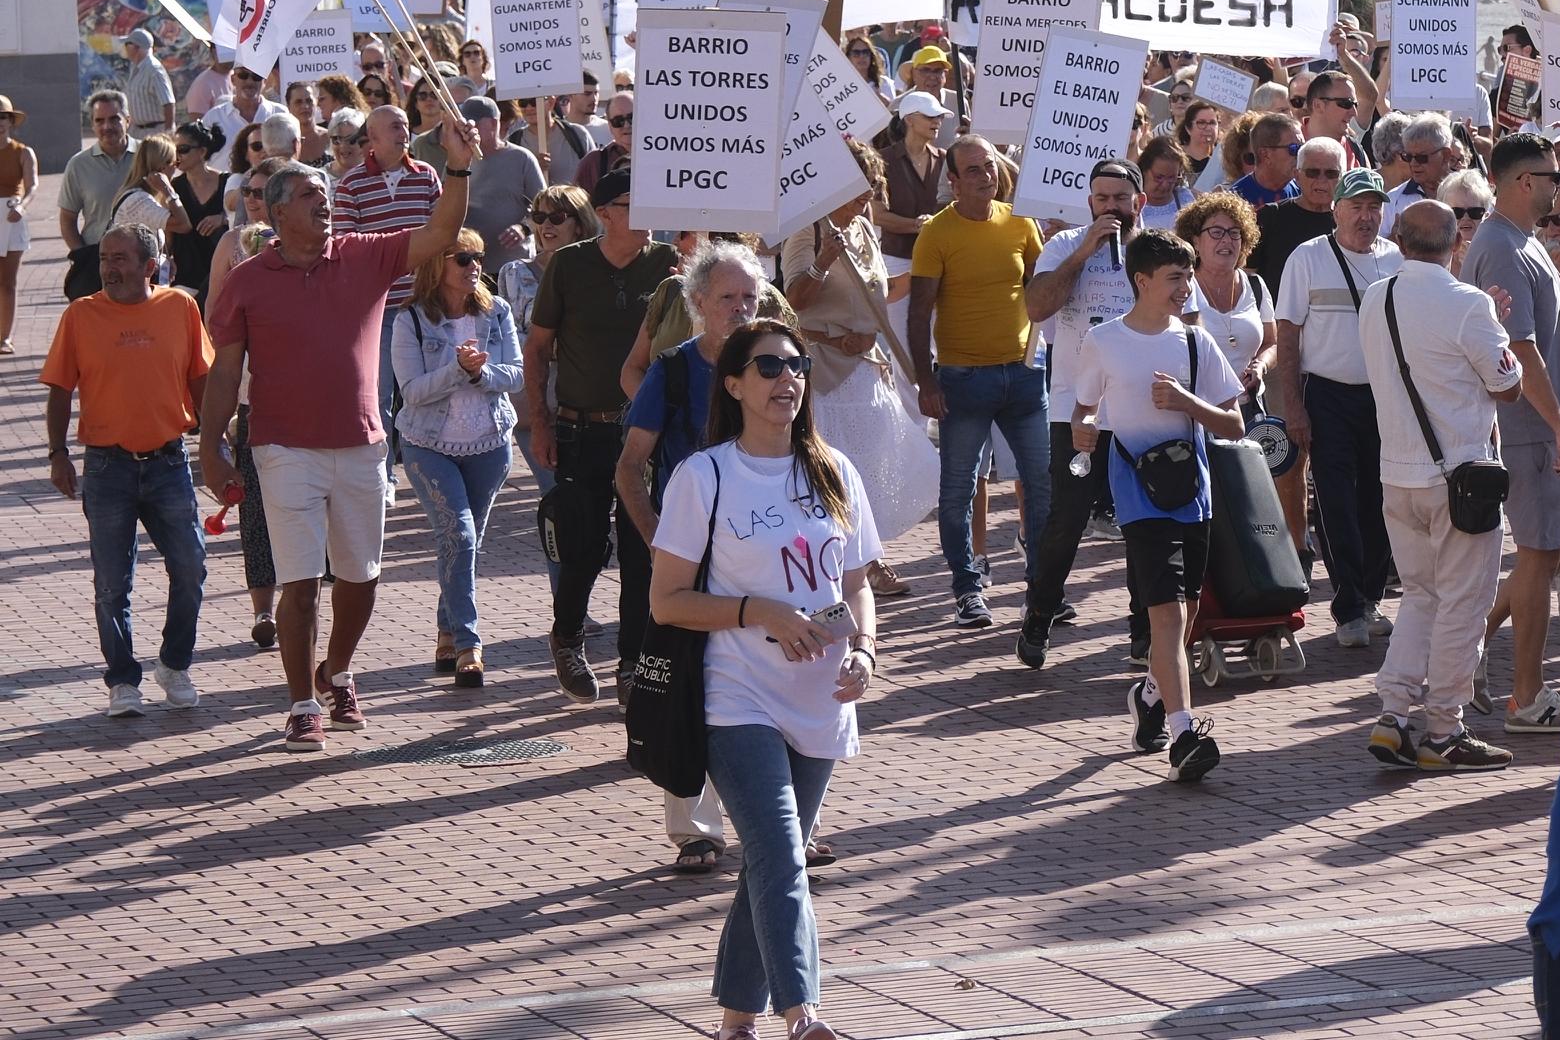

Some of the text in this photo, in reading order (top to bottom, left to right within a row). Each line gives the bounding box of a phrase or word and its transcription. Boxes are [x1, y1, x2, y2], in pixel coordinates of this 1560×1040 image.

[494, 0, 572, 15] GUANARTEME
[509, 18, 559, 33] UNIDOS
[985, 15, 1021, 27] REINA
[1409, 19, 1457, 32] UNIDOS
[295, 26, 336, 38] BARRIO
[285, 44, 347, 57] LAS TORRES
[499, 36, 572, 53] SOMOS MÁS
[668, 36, 749, 55] BARRIO
[1001, 38, 1044, 53] UNID
[1397, 41, 1468, 56] SOMOS MÁS
[296, 62, 338, 73] UNIDOS
[514, 59, 553, 73] LPGC
[983, 63, 1040, 79] SOMOS
[1065, 52, 1120, 75] BARRIO
[645, 69, 769, 89] LAS TORRES
[1411, 68, 1447, 83] LPGC
[999, 91, 1035, 108] LPG
[1053, 80, 1120, 105] EL BATAN
[664, 103, 748, 122] UNIDOS
[1052, 110, 1109, 133] UNIDOS
[643, 135, 715, 153] SOMOS
[721, 135, 765, 154] MÁS
[796, 122, 826, 151] MÁS
[1033, 135, 1082, 157] SOMOS
[665, 169, 728, 190] LPGC
[779, 161, 818, 197] PGC
[1042, 166, 1086, 190] LPGC
[727, 505, 784, 540] LAS
[780, 536, 843, 594] NO
[635, 663, 672, 683] EPUBLIC
